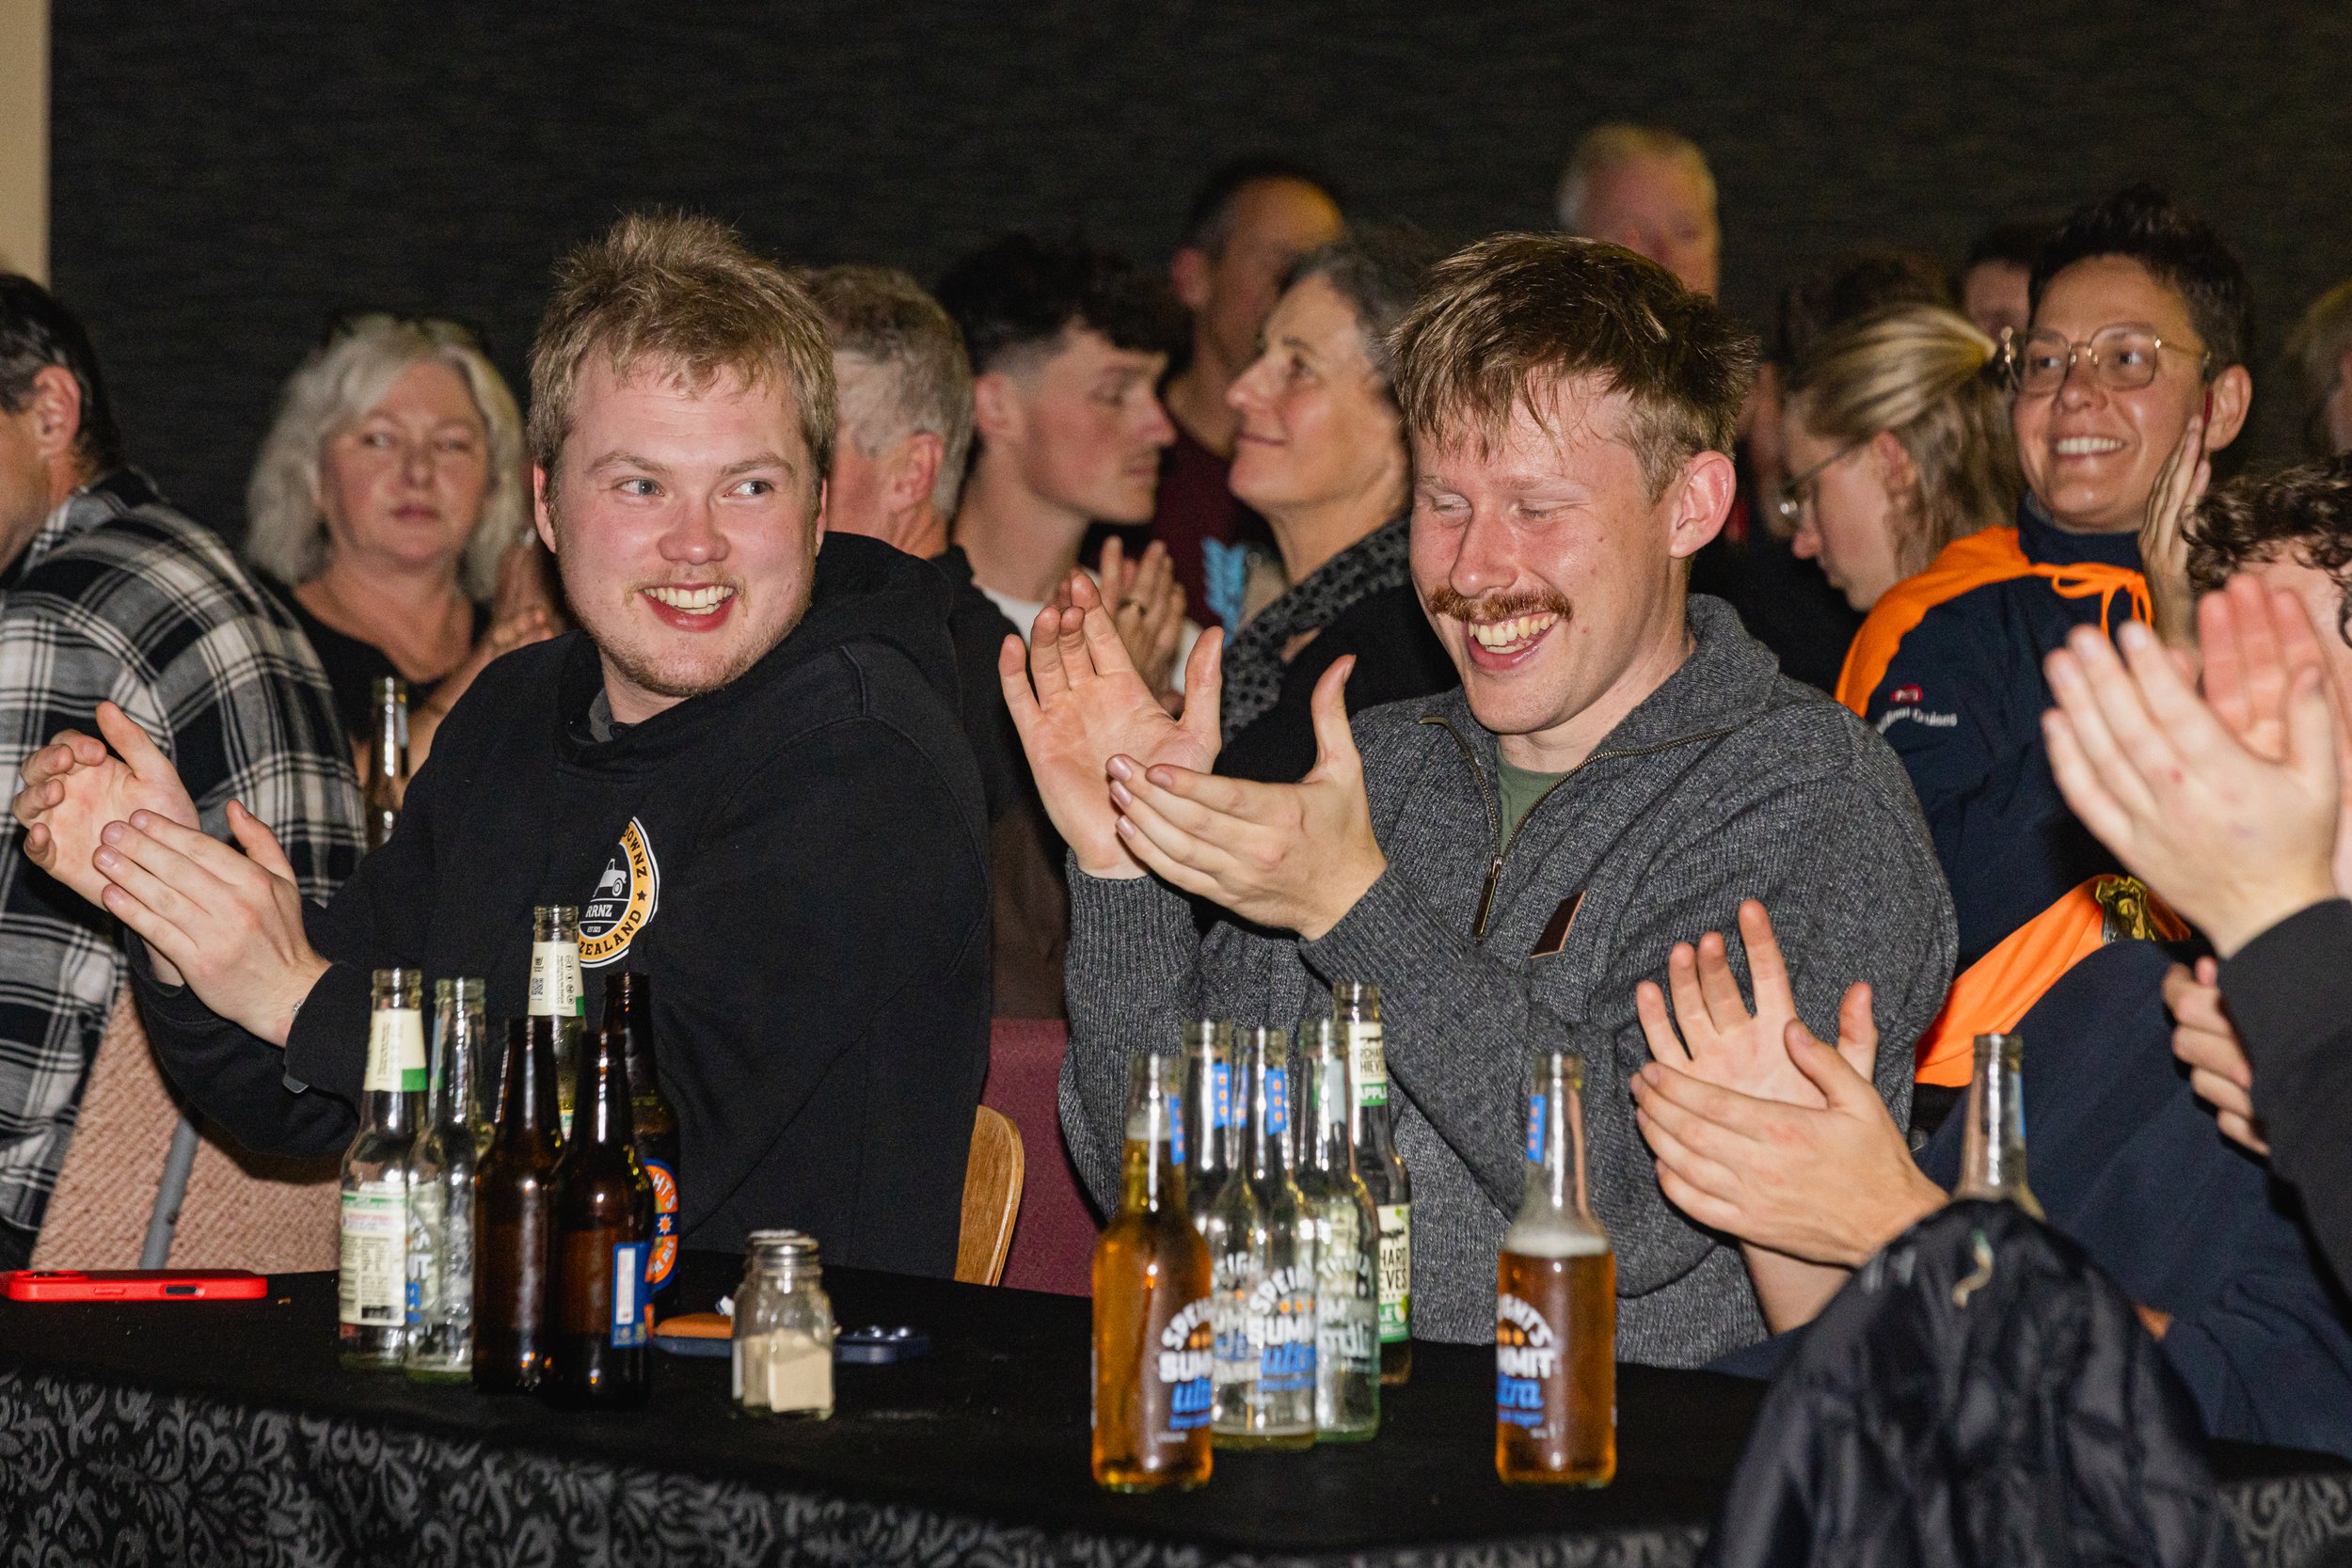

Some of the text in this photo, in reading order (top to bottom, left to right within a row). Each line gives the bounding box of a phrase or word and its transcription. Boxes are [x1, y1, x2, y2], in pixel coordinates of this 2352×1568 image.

[585, 904, 613, 918] RRNZ
[579, 910, 642, 956] ZEALAND
[648, 1171, 677, 1212] HT'S
